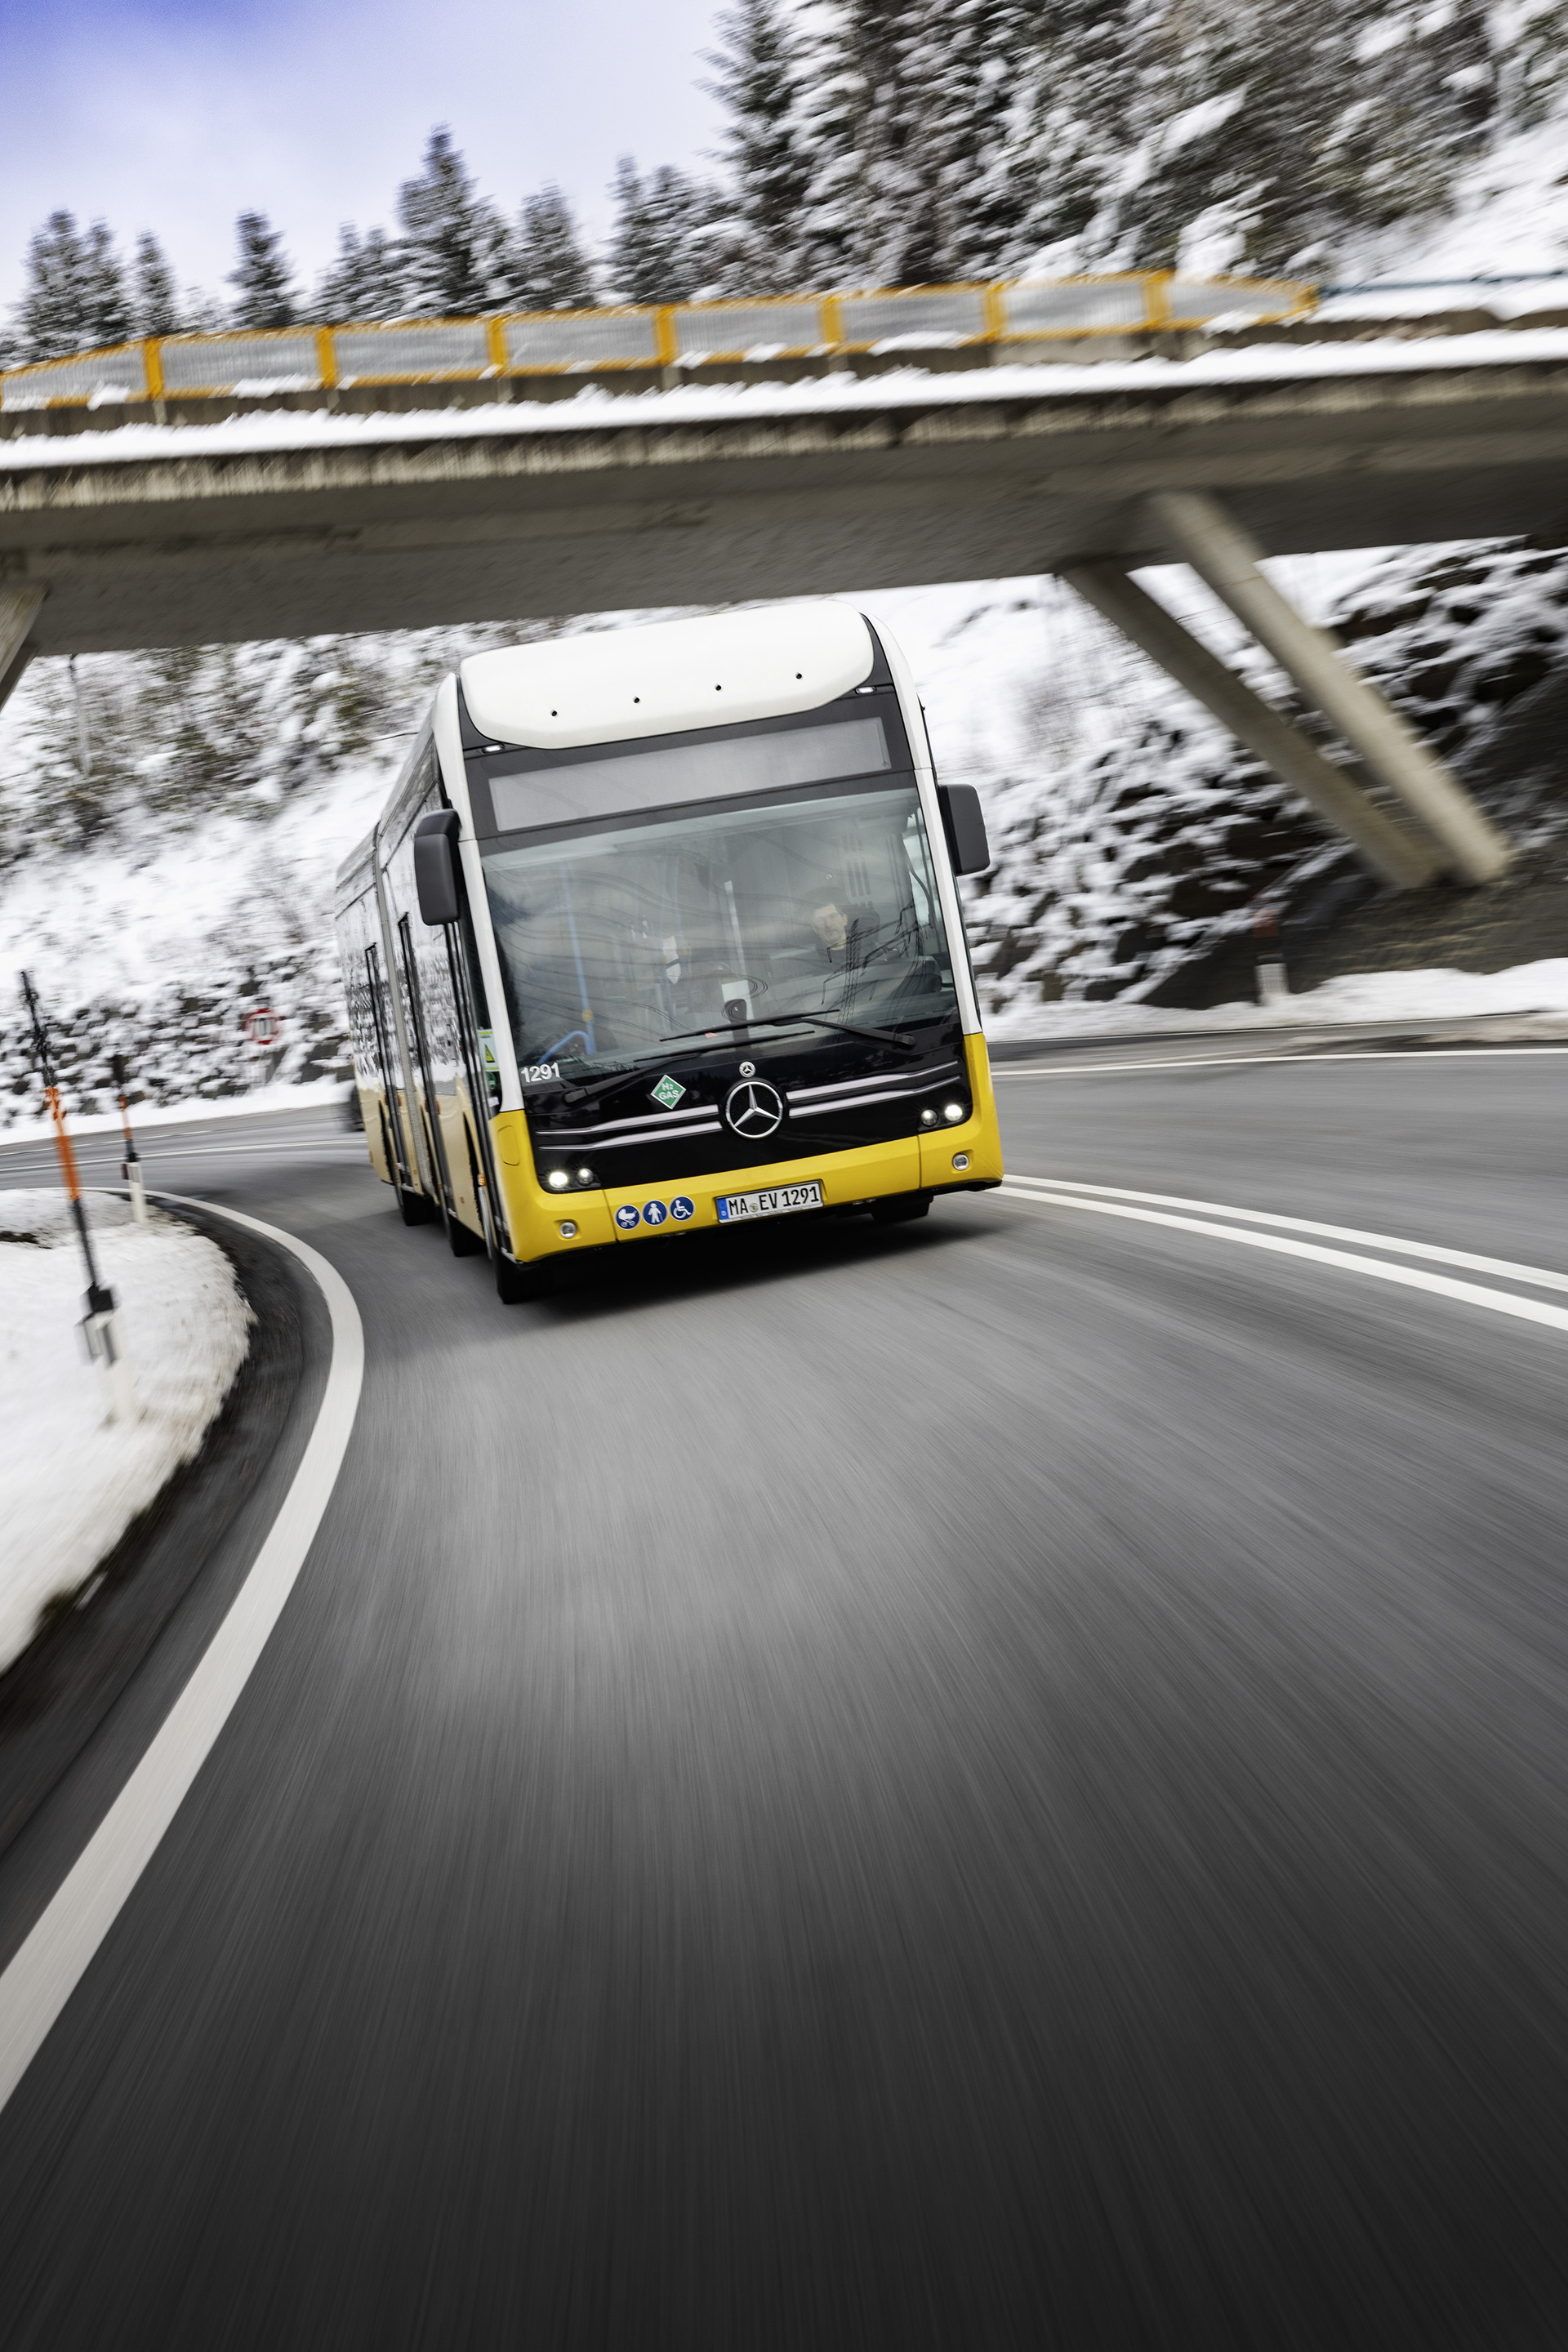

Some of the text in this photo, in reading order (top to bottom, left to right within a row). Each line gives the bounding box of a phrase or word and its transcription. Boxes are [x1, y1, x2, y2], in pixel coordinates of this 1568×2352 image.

[520, 1062, 560, 1083] 1291
[658, 1089, 679, 1100] GAS
[728, 1186, 819, 1216] MA EV 1291
